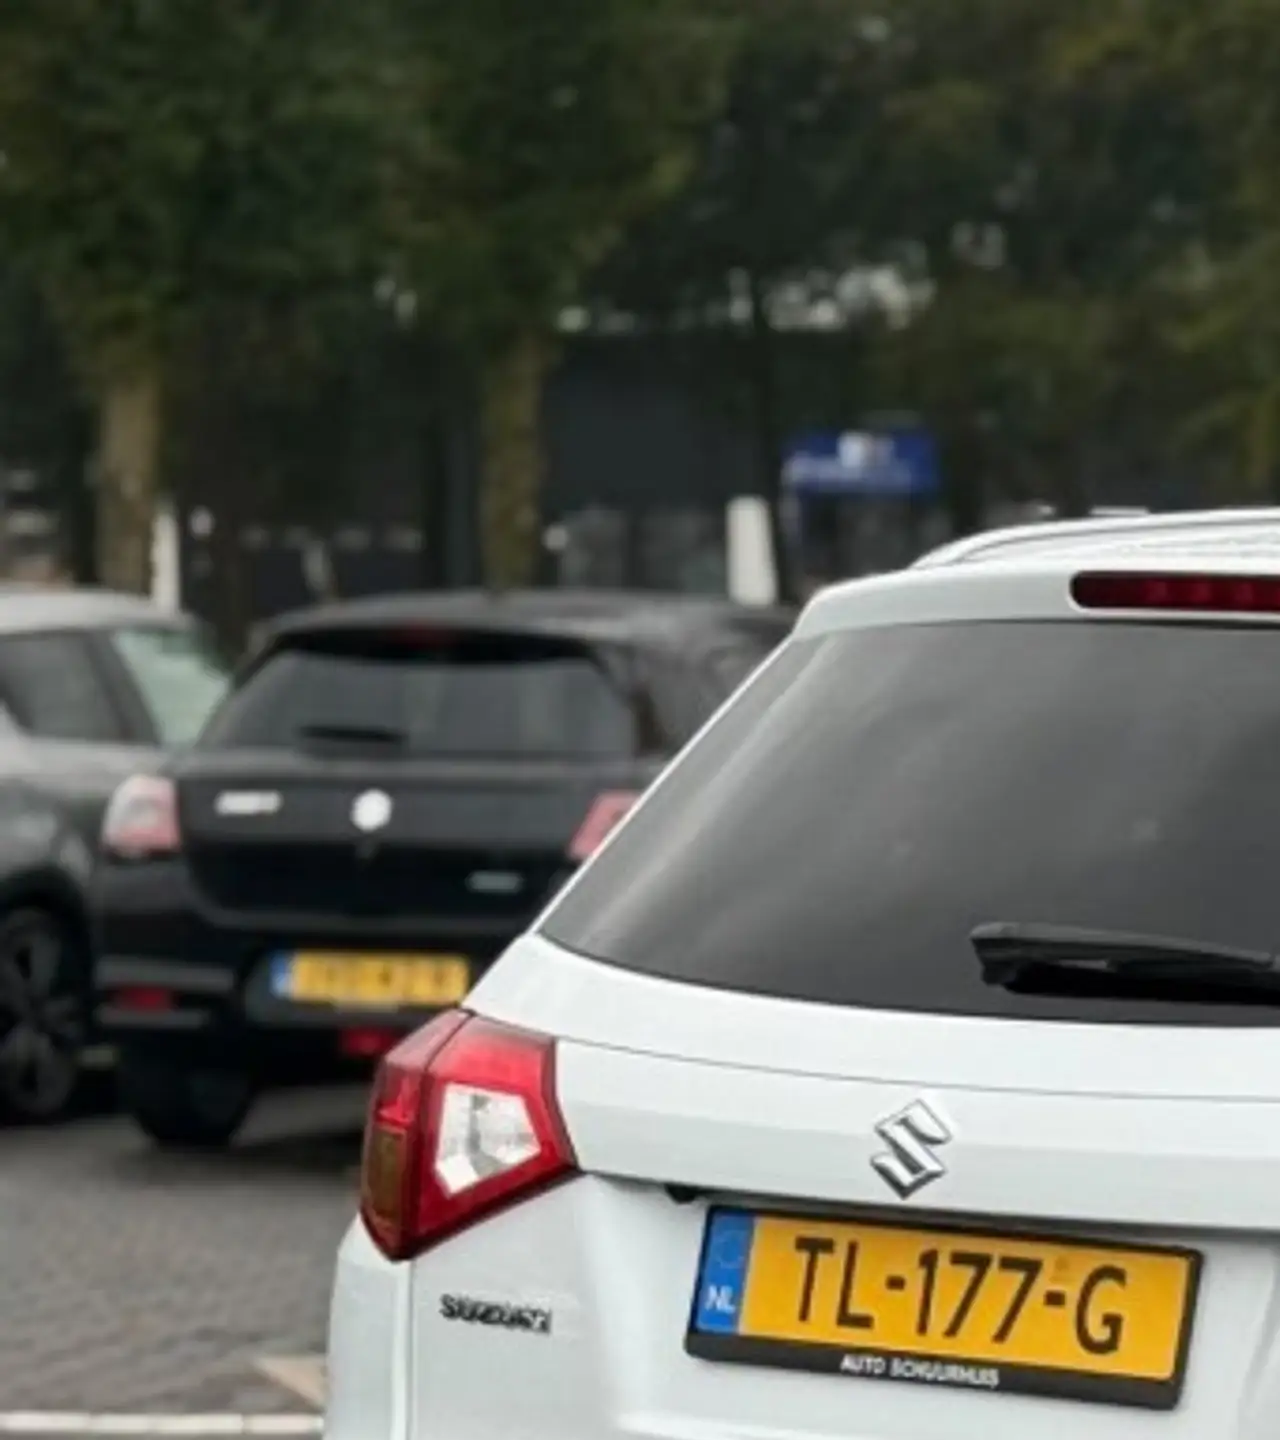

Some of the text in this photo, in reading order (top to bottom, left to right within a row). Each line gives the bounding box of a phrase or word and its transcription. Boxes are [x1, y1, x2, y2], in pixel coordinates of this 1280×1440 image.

[705, 1285, 735, 1314] NL
[795, 1236, 1127, 1354] TL-177-G
[840, 1353, 885, 1375] AUTO
